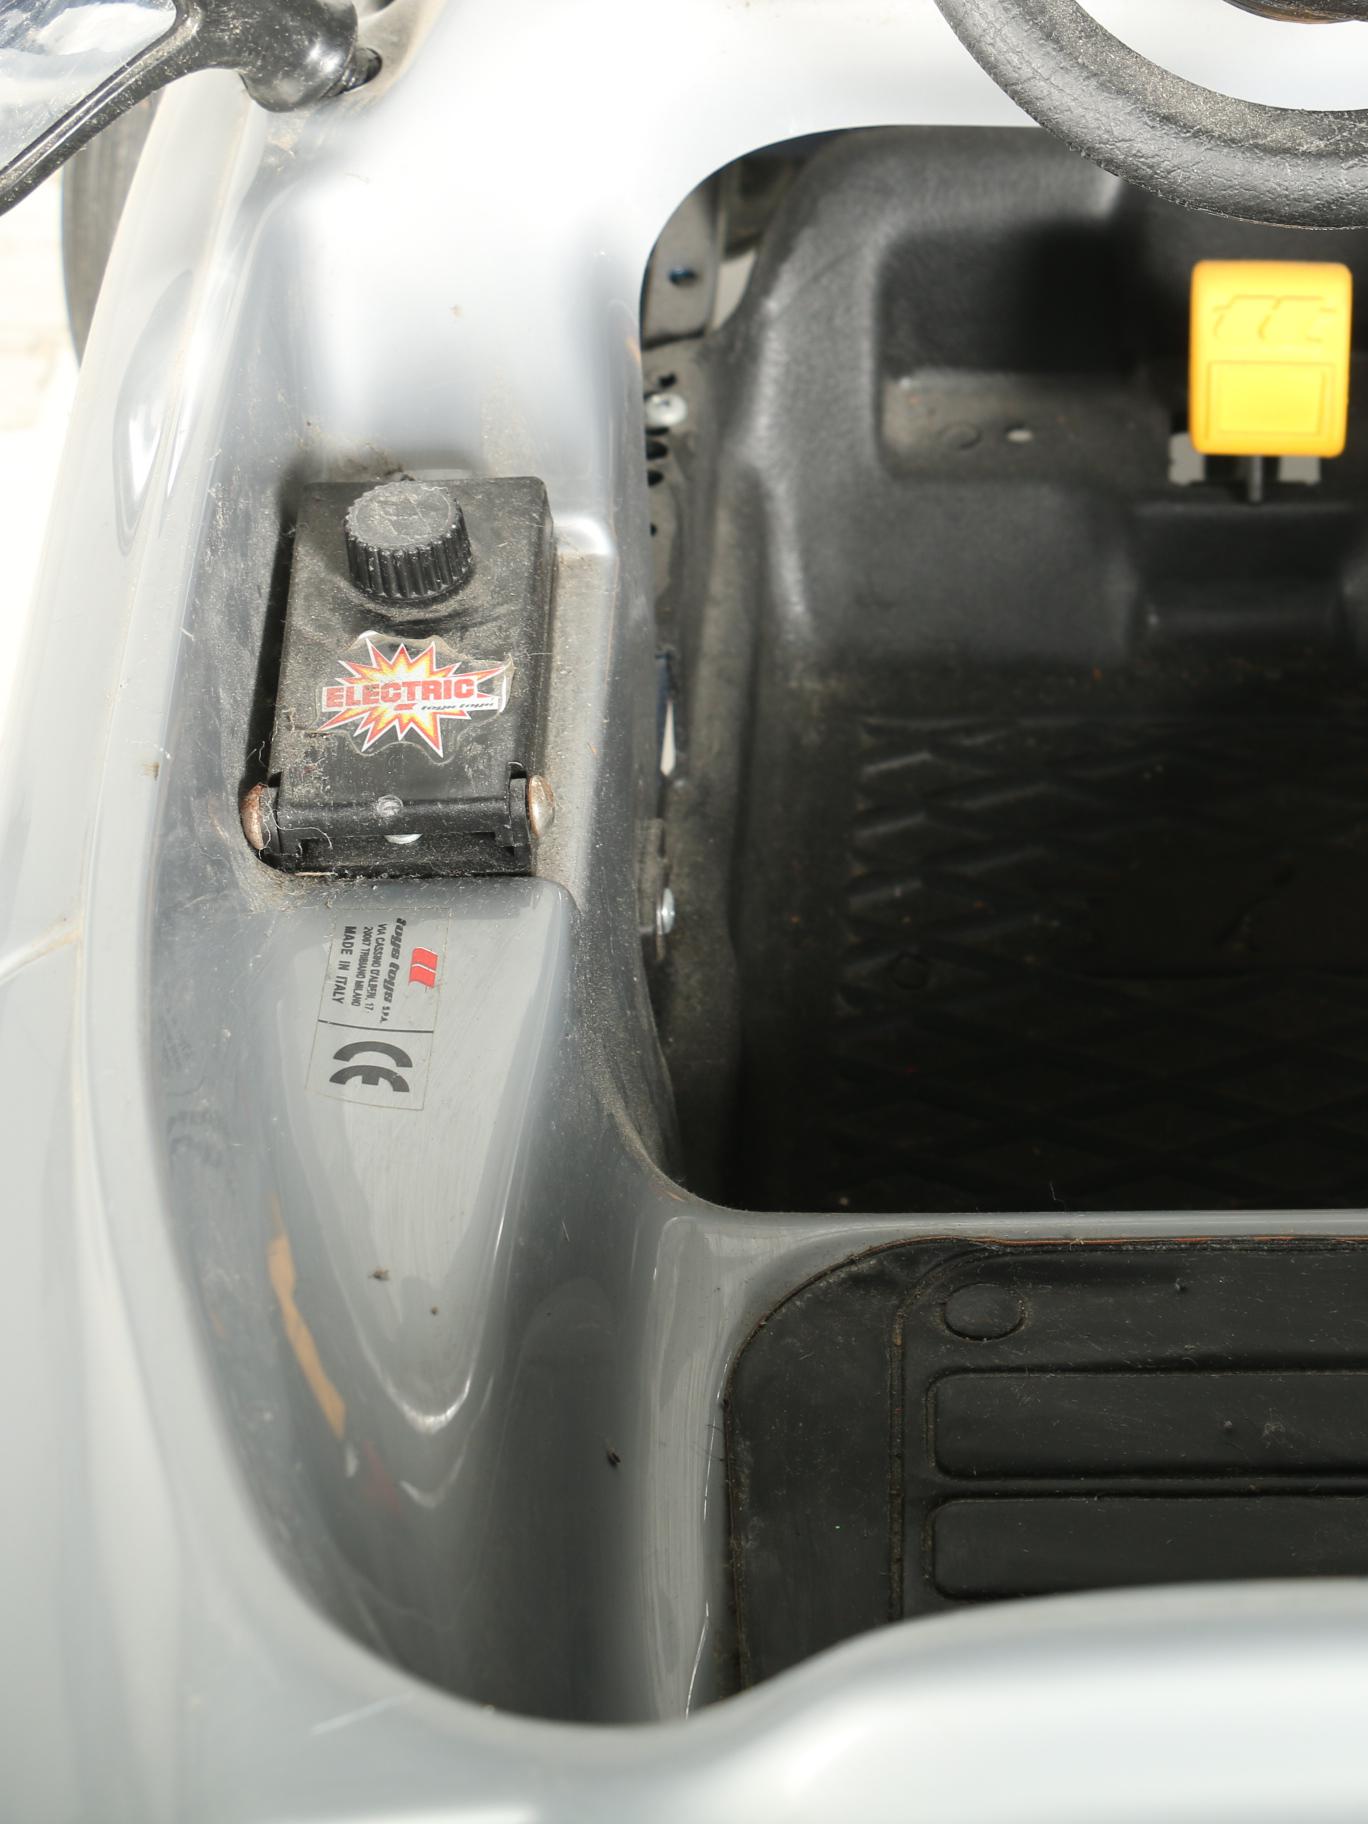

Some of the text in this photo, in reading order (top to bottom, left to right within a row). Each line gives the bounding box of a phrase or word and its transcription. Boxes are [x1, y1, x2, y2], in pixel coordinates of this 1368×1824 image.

[325, 678, 476, 709] ELECTRIC
[376, 923, 388, 936] VIA
[332, 926, 357, 1005] MADE IN ITALY
[371, 937, 386, 968] CASSINO
[351, 980, 365, 1007] MILANO
